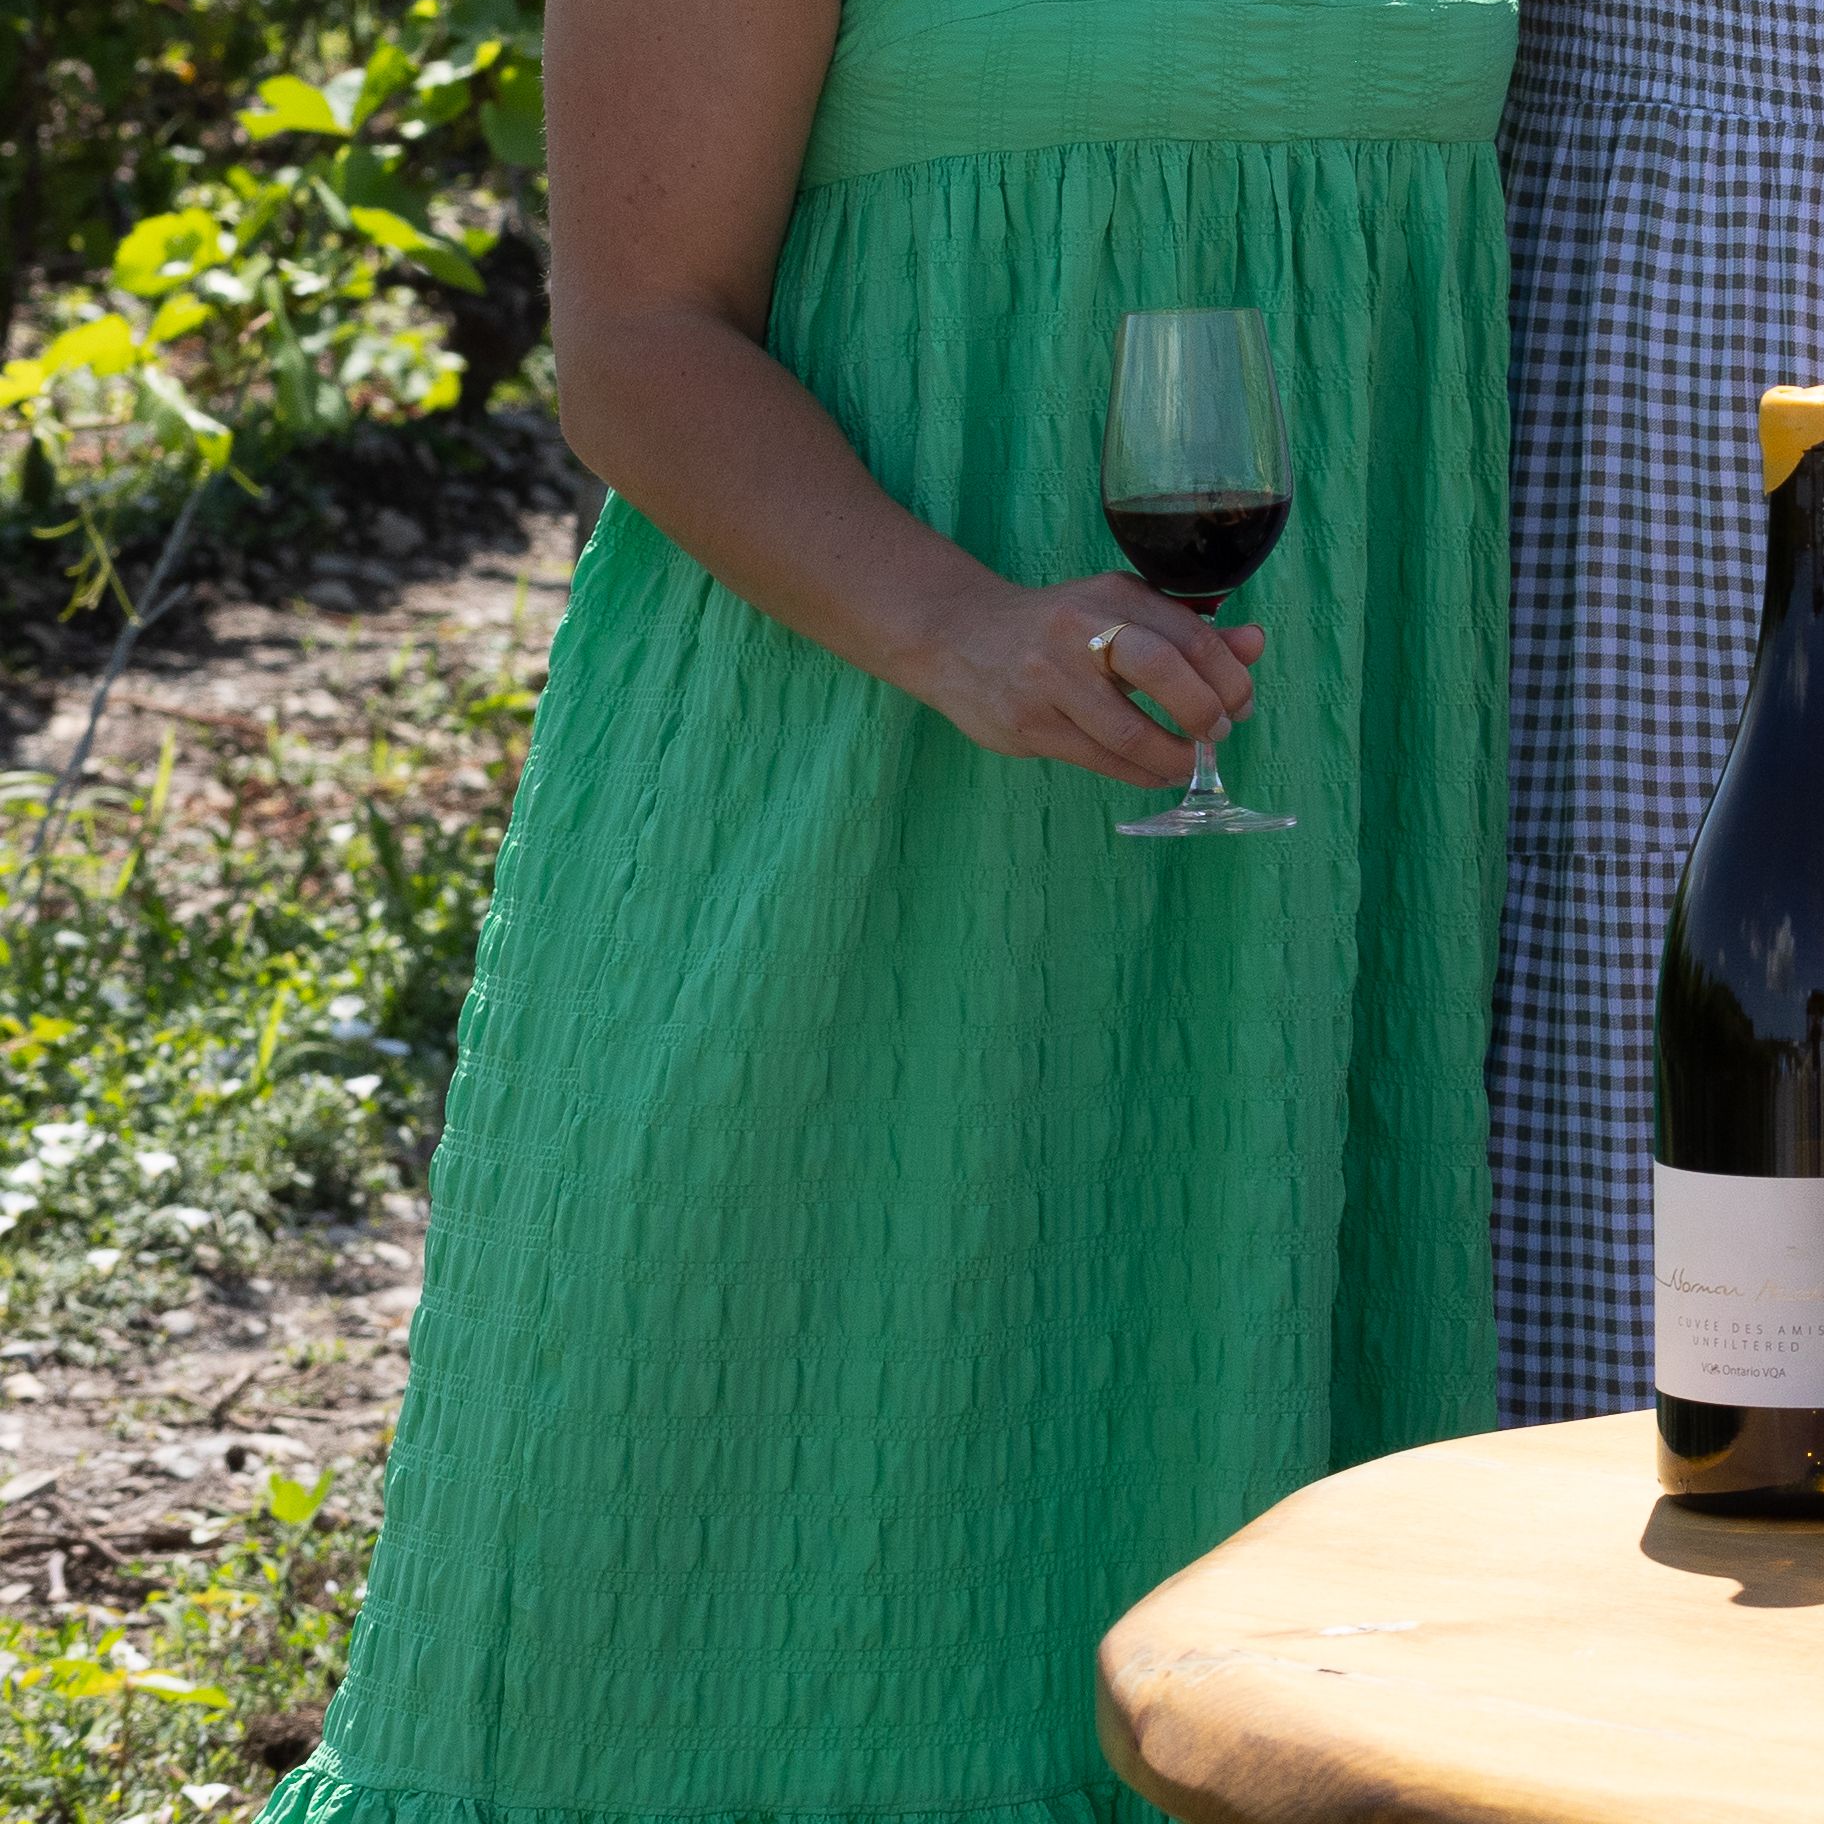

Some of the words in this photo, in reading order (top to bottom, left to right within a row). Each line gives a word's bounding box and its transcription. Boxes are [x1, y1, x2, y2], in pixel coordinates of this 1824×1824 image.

[1669, 1267, 1745, 1297] Norman
[1732, 1322, 1763, 1335] DES
[1778, 1325, 1824, 1336] AMIS
[1692, 1336, 1800, 1352] UNFILTERED
[1722, 1364, 1760, 1378] Ontario
[1762, 1367, 1786, 1378] VQA
